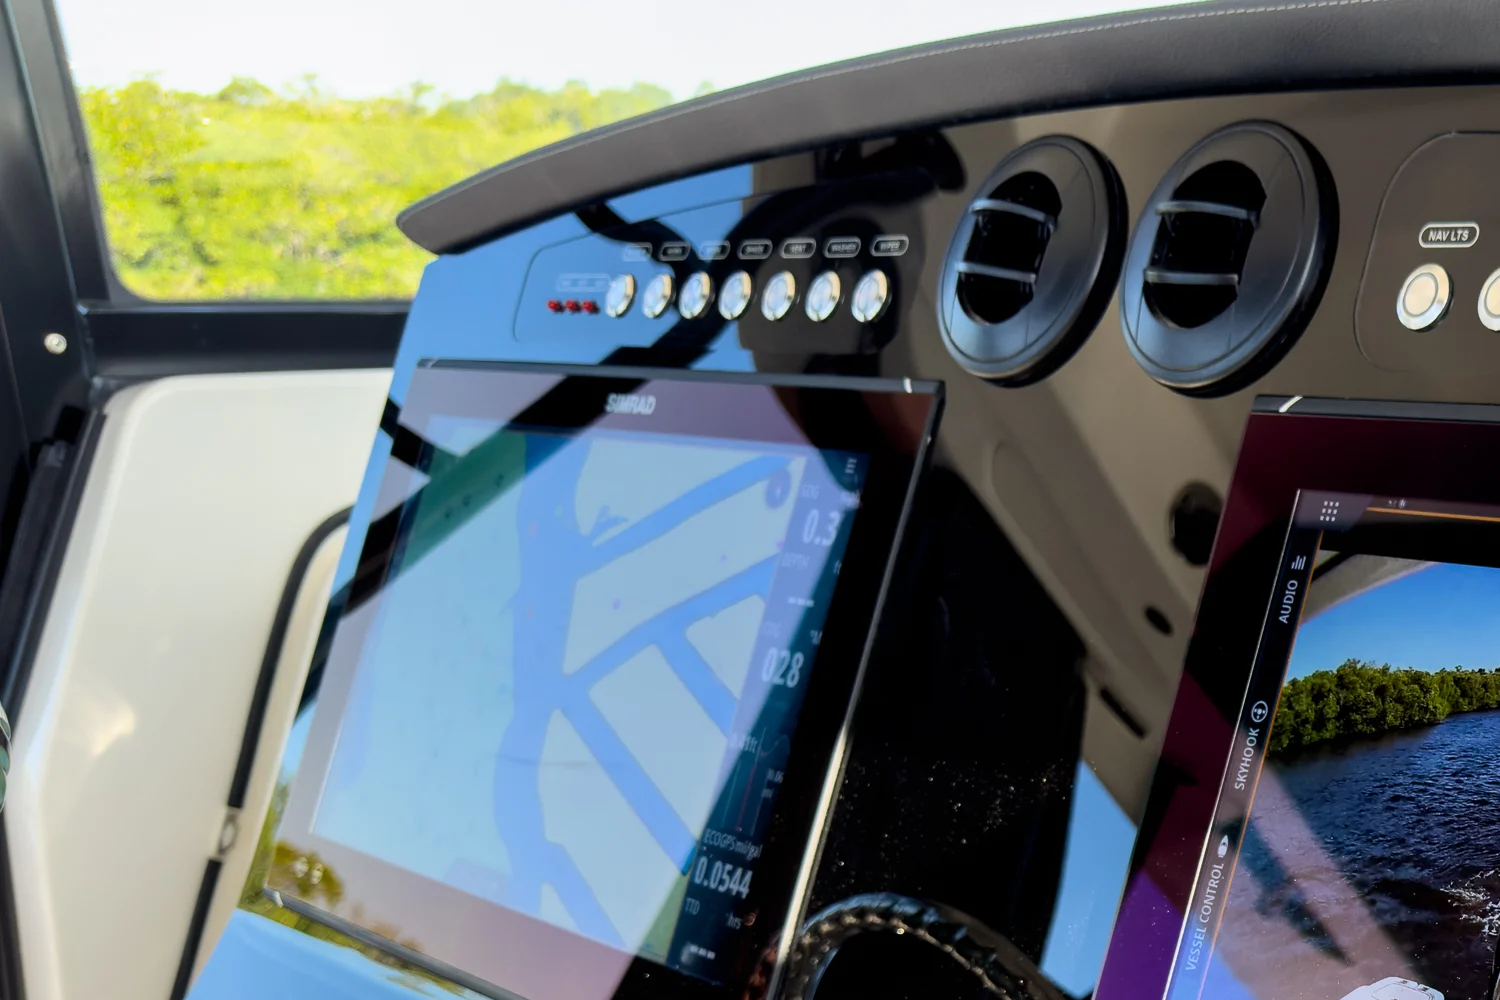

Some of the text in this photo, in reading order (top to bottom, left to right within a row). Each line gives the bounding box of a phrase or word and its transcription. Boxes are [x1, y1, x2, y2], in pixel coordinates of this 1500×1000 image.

[1427, 229, 1469, 242] NAV LTS
[605, 393, 657, 416] SIMRAD
[802, 508, 842, 547] 0.3
[1278, 579, 1298, 624] AUDIO
[761, 647, 805, 687] 028
[1234, 728, 1260, 790] SKYHOOK
[693, 855, 754, 899] 0.0544
[1185, 863, 1224, 972] VESSEL CONTROL
